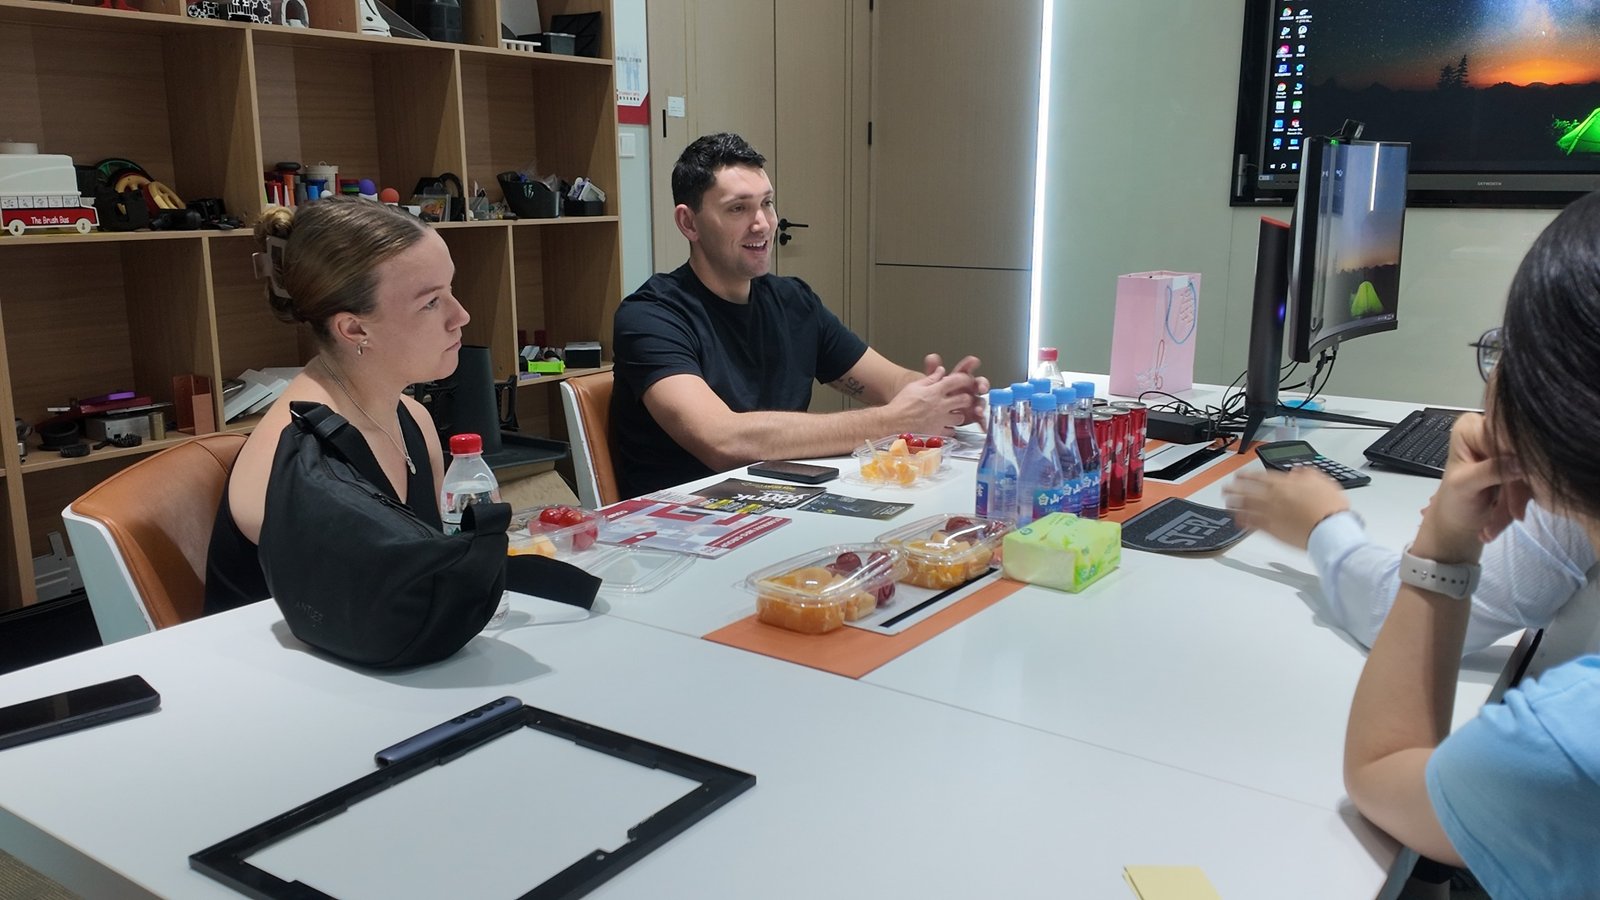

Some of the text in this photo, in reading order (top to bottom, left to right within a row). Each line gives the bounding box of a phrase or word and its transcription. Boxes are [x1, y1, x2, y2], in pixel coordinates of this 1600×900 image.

[31, 215, 69, 224] The Brush Bus
[1038, 493, 1063, 506] 白山
